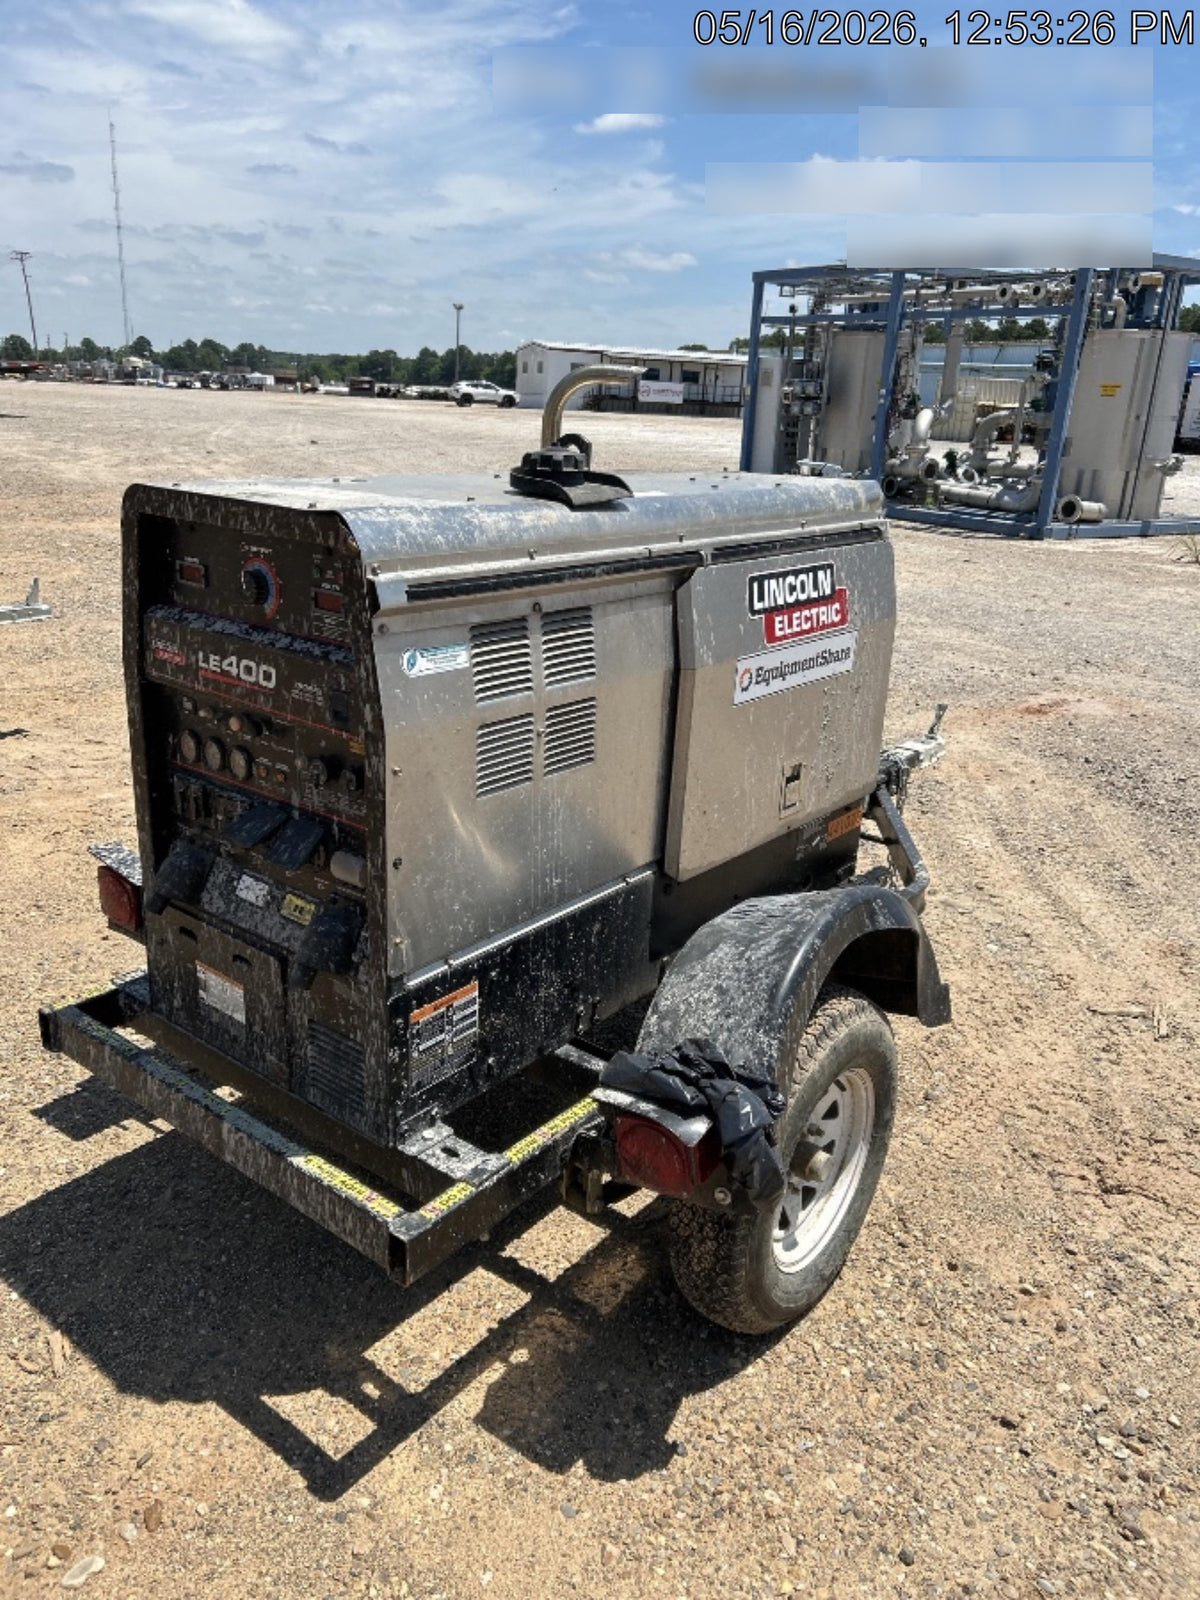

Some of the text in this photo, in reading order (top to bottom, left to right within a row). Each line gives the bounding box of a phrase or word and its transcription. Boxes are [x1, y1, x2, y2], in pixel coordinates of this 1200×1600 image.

[753, 568, 832, 611] LINCOLN
[774, 602, 842, 638] ELECTRIC
[198, 650, 277, 689] LE400
[754, 646, 852, 687] EquipmentShare
